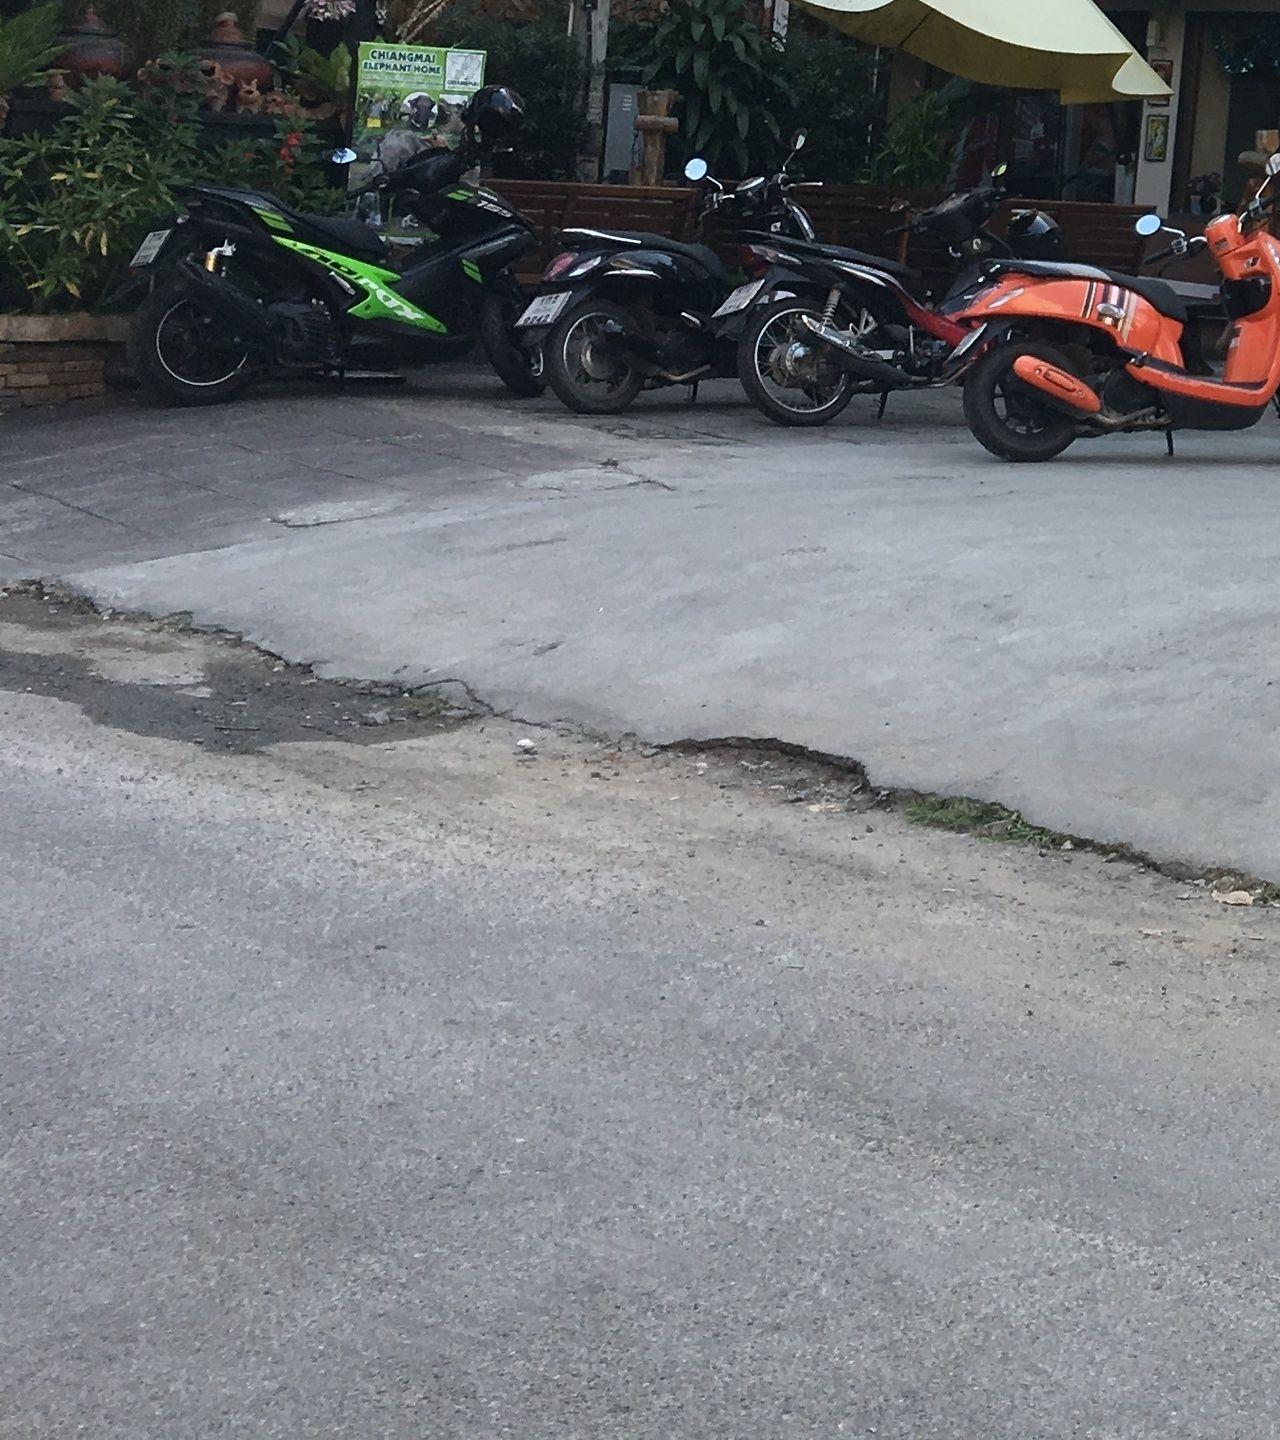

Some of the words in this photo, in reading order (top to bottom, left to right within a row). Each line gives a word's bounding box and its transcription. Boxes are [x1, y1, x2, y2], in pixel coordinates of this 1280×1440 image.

[370, 50, 436, 64] CHIANGMAI
[363, 61, 412, 72] ELEPHANT
[413, 64, 441, 74] HOME
